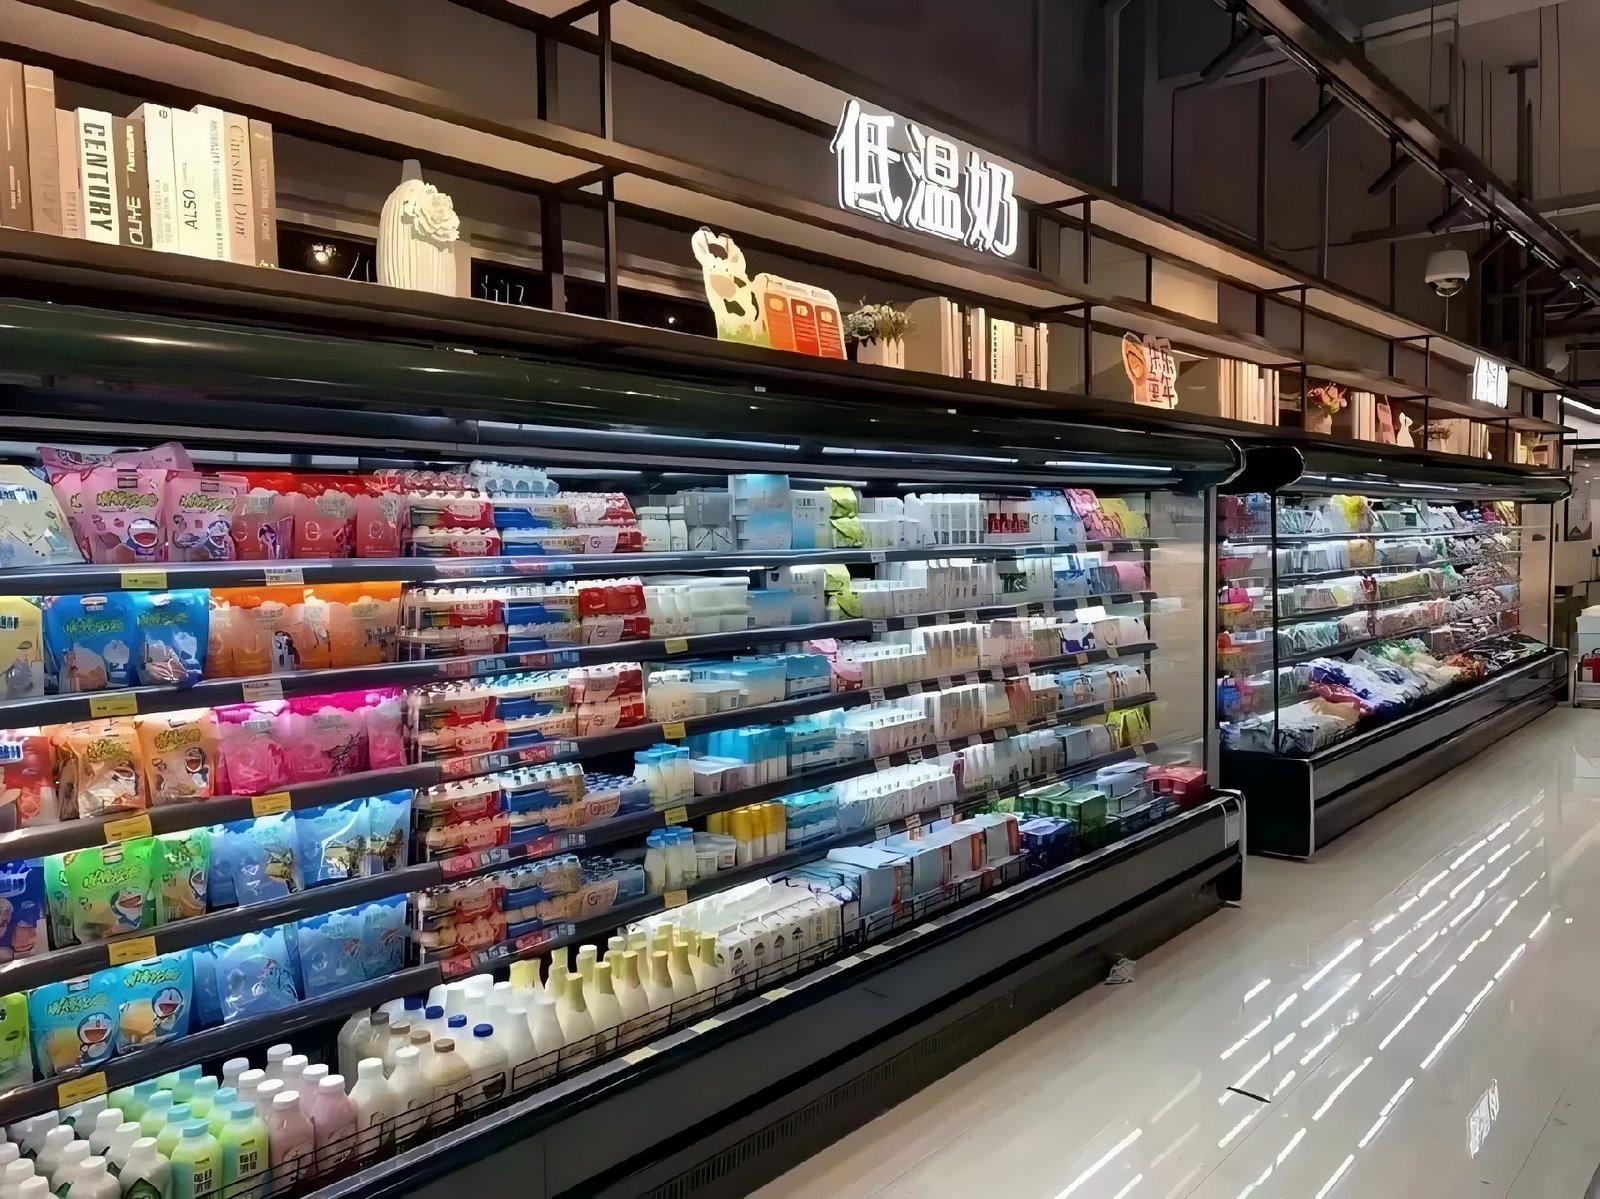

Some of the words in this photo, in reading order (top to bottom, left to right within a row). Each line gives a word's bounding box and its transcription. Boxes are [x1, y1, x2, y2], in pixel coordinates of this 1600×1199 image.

[84, 122, 113, 231] CENTURY
[182, 189, 198, 230] ALSO
[830, 99, 1018, 258] 低温奶
